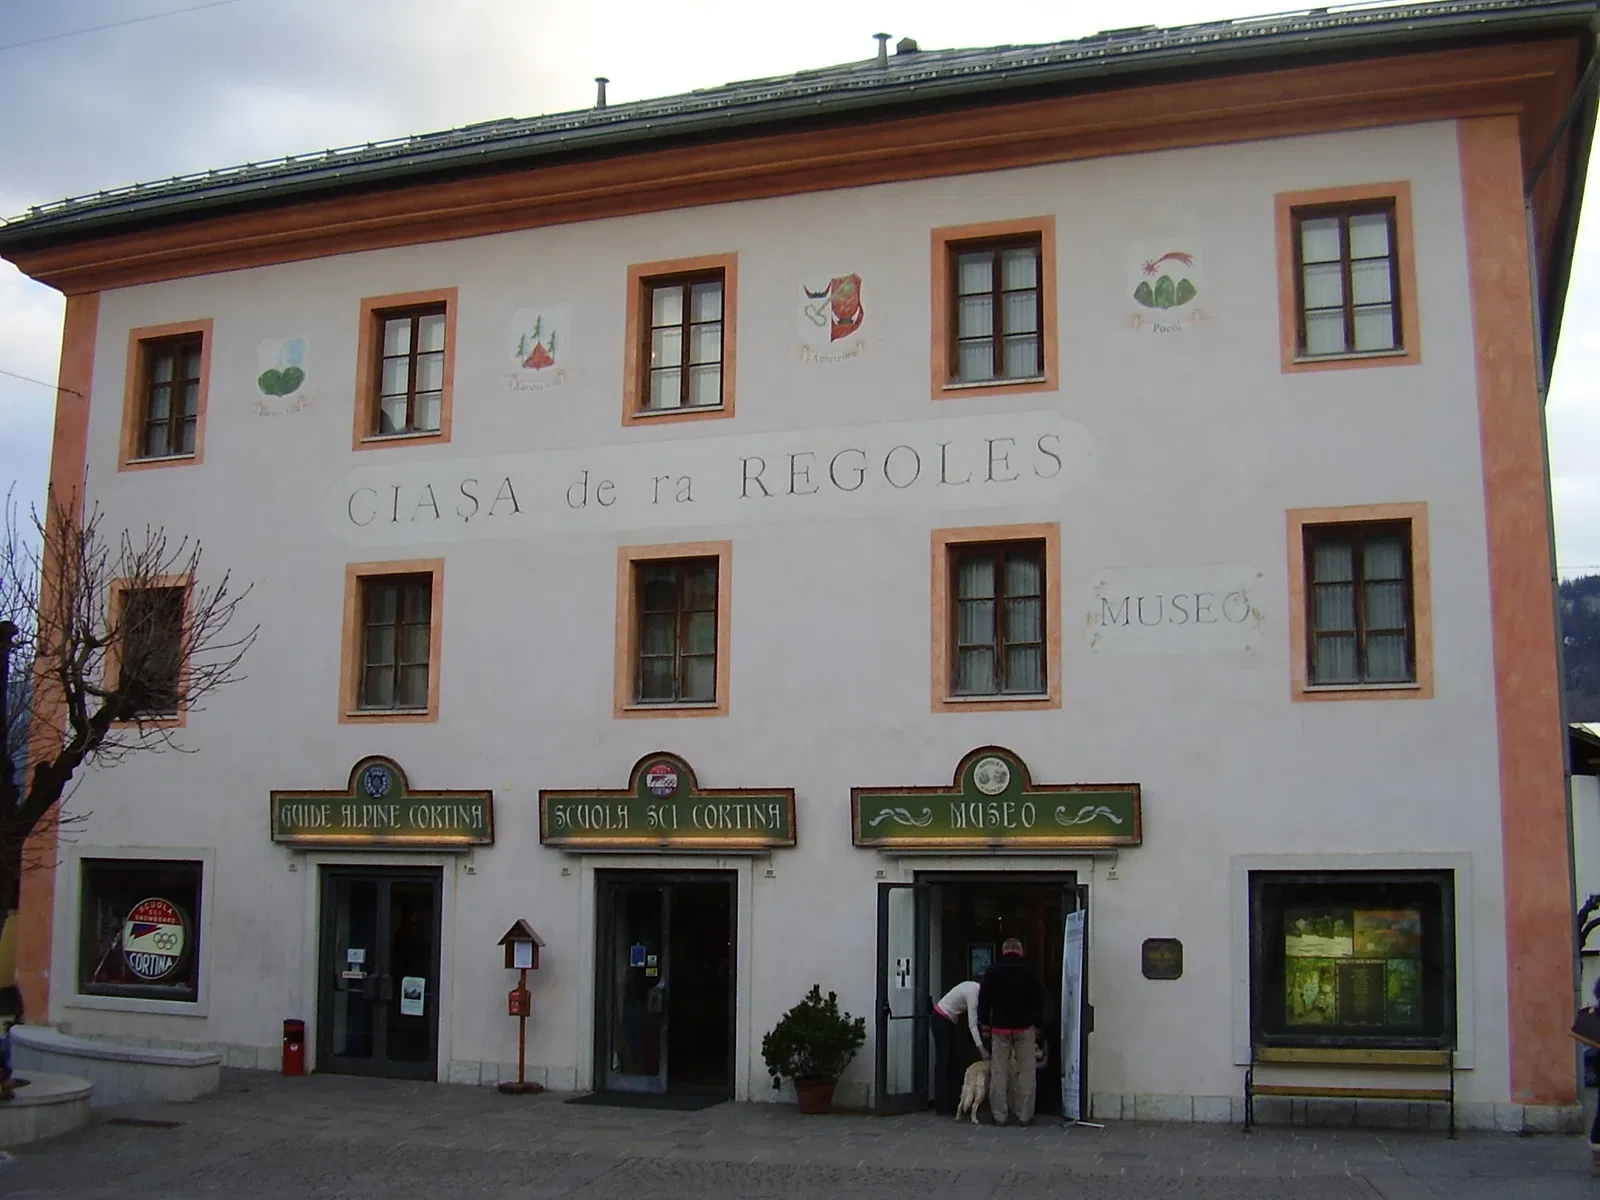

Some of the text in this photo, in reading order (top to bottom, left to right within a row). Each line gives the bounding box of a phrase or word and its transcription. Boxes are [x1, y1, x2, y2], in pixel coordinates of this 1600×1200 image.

[566, 470, 617, 509] de
[652, 475, 695, 505] ra
[738, 434, 1063, 499] REGOLES
[1100, 591, 1251, 627] MUSEO
[281, 804, 484, 829] GUIDE ALPINE CORTINA
[555, 803, 781, 829] SCUOLA SCI CORTINA
[949, 801, 1036, 829] MUSEO
[135, 915, 175, 923] SNOWBOARD
[139, 902, 173, 914] SCUOLA
[129, 953, 172, 975] CORTINA
